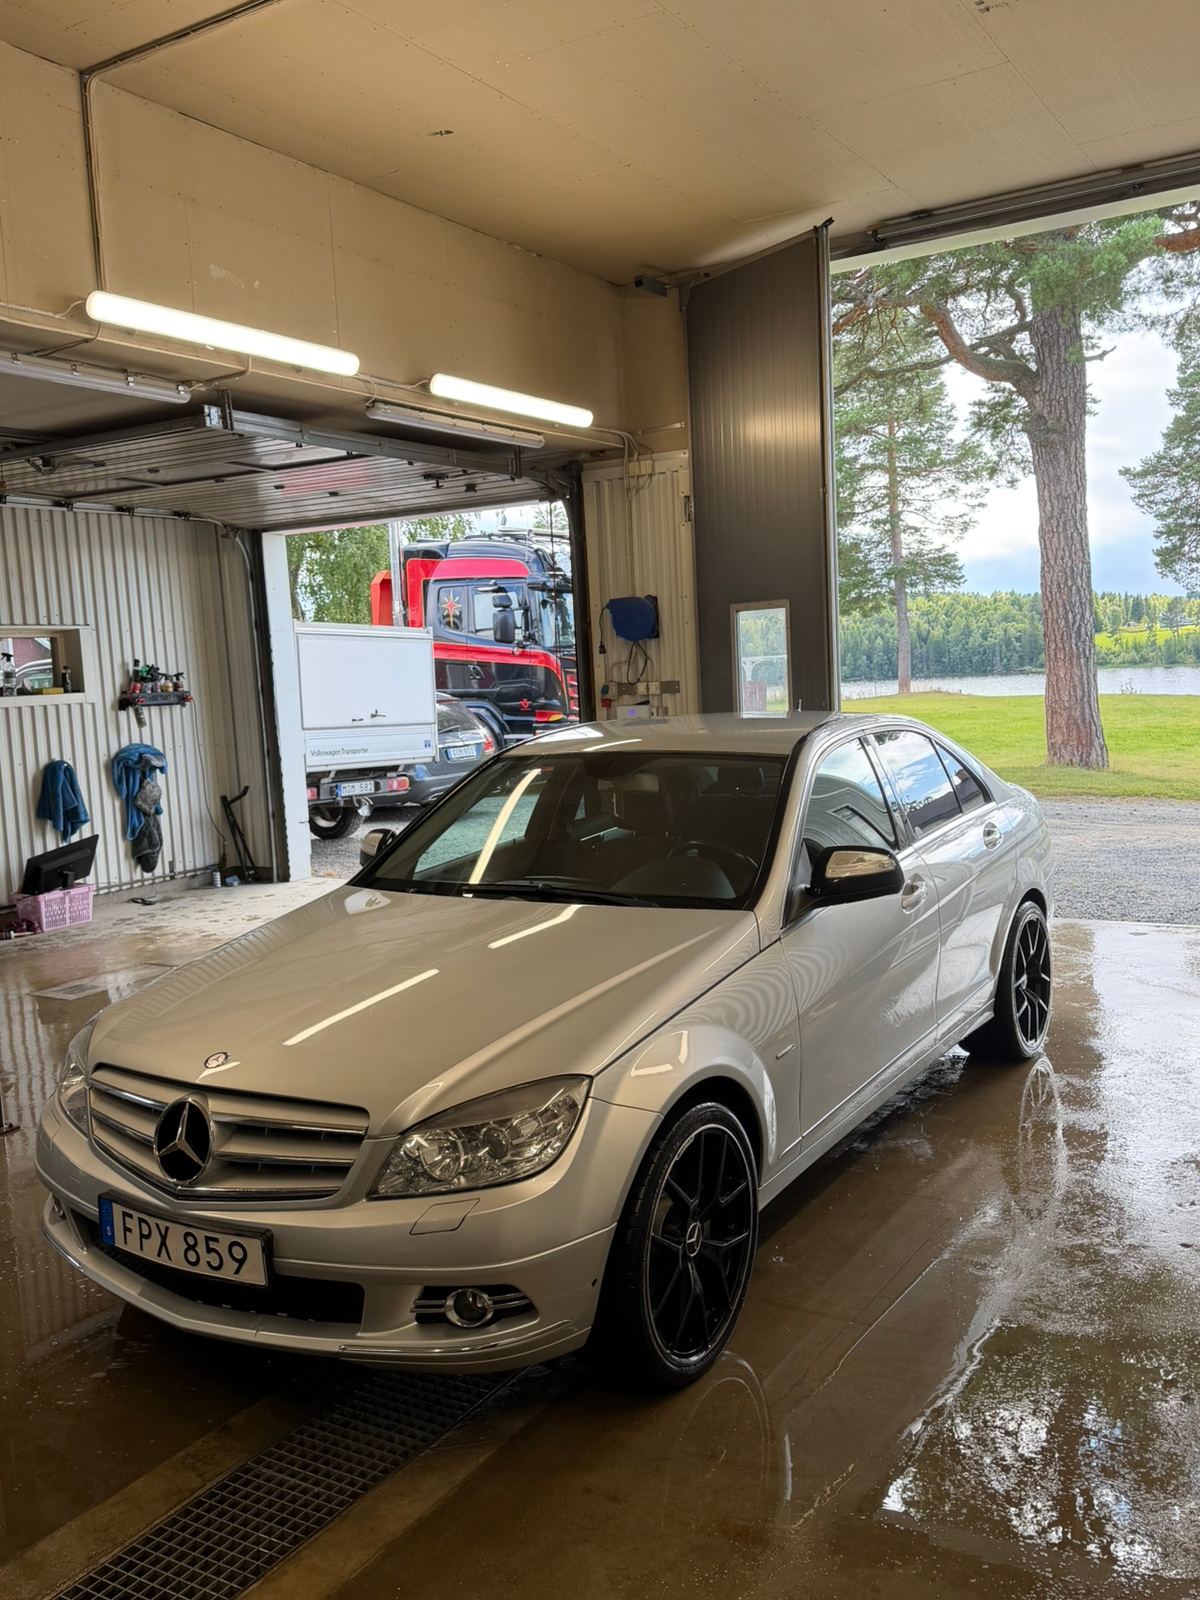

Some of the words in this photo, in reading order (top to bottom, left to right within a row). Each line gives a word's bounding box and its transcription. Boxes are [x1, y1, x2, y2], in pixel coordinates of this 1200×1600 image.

[310, 749, 341, 757] Volkswagen
[341, 747, 369, 755] Transporter
[359, 782, 373, 793] 582
[106, 1225, 112, 1236] S
[121, 1210, 172, 1262] FPX
[183, 1231, 248, 1275] 859
